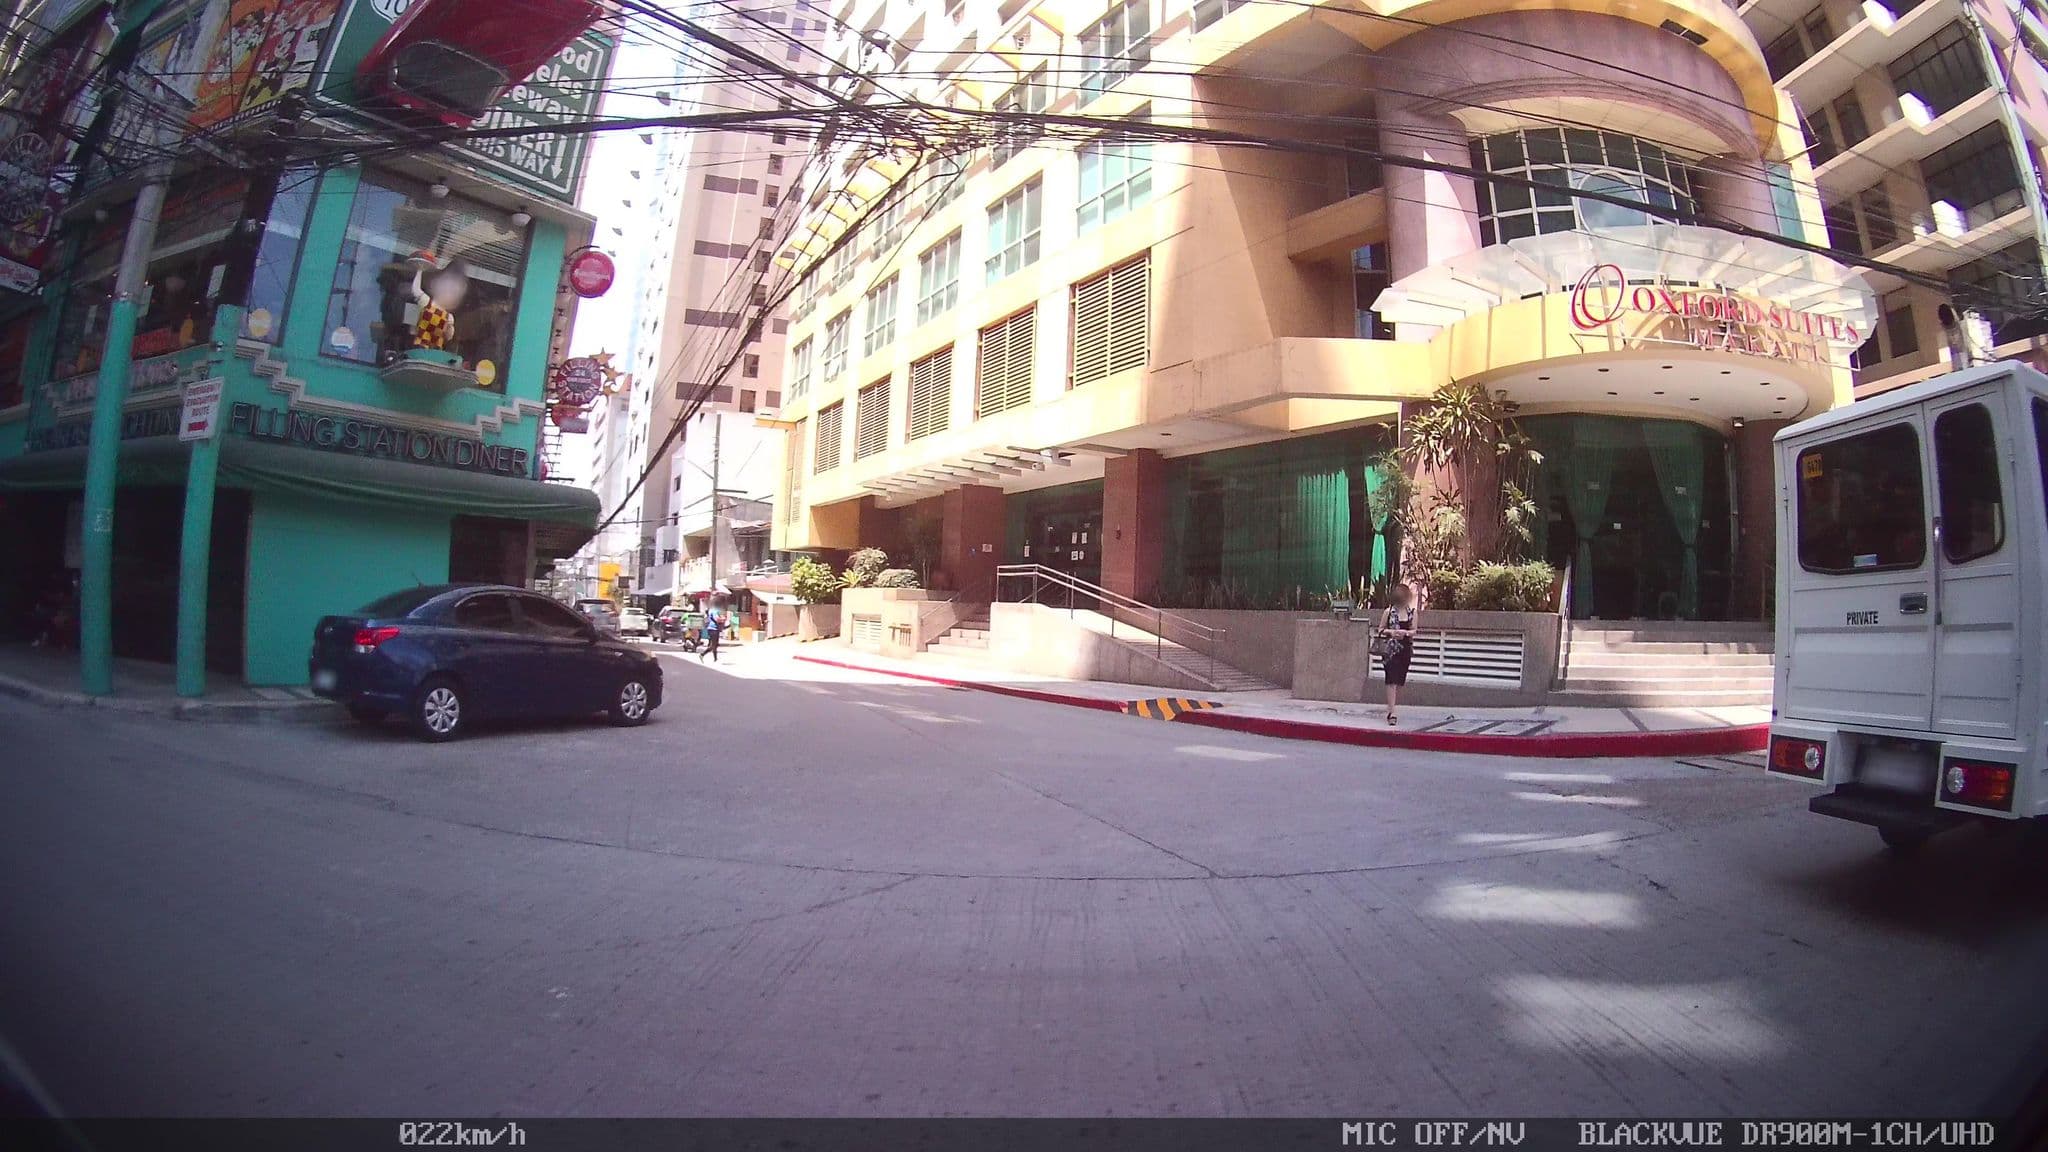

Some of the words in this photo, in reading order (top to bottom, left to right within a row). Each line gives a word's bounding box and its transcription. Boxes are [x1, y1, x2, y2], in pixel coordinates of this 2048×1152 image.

[510, 144, 550, 174] WAY
[1633, 286, 1764, 328] OXFORD
[1770, 308, 1860, 345] SUITES
[231, 402, 336, 446] FILLING
[344, 421, 450, 461] STATION
[455, 439, 530, 475] DINER
[1846, 611, 1879, 625] PRIVATE
